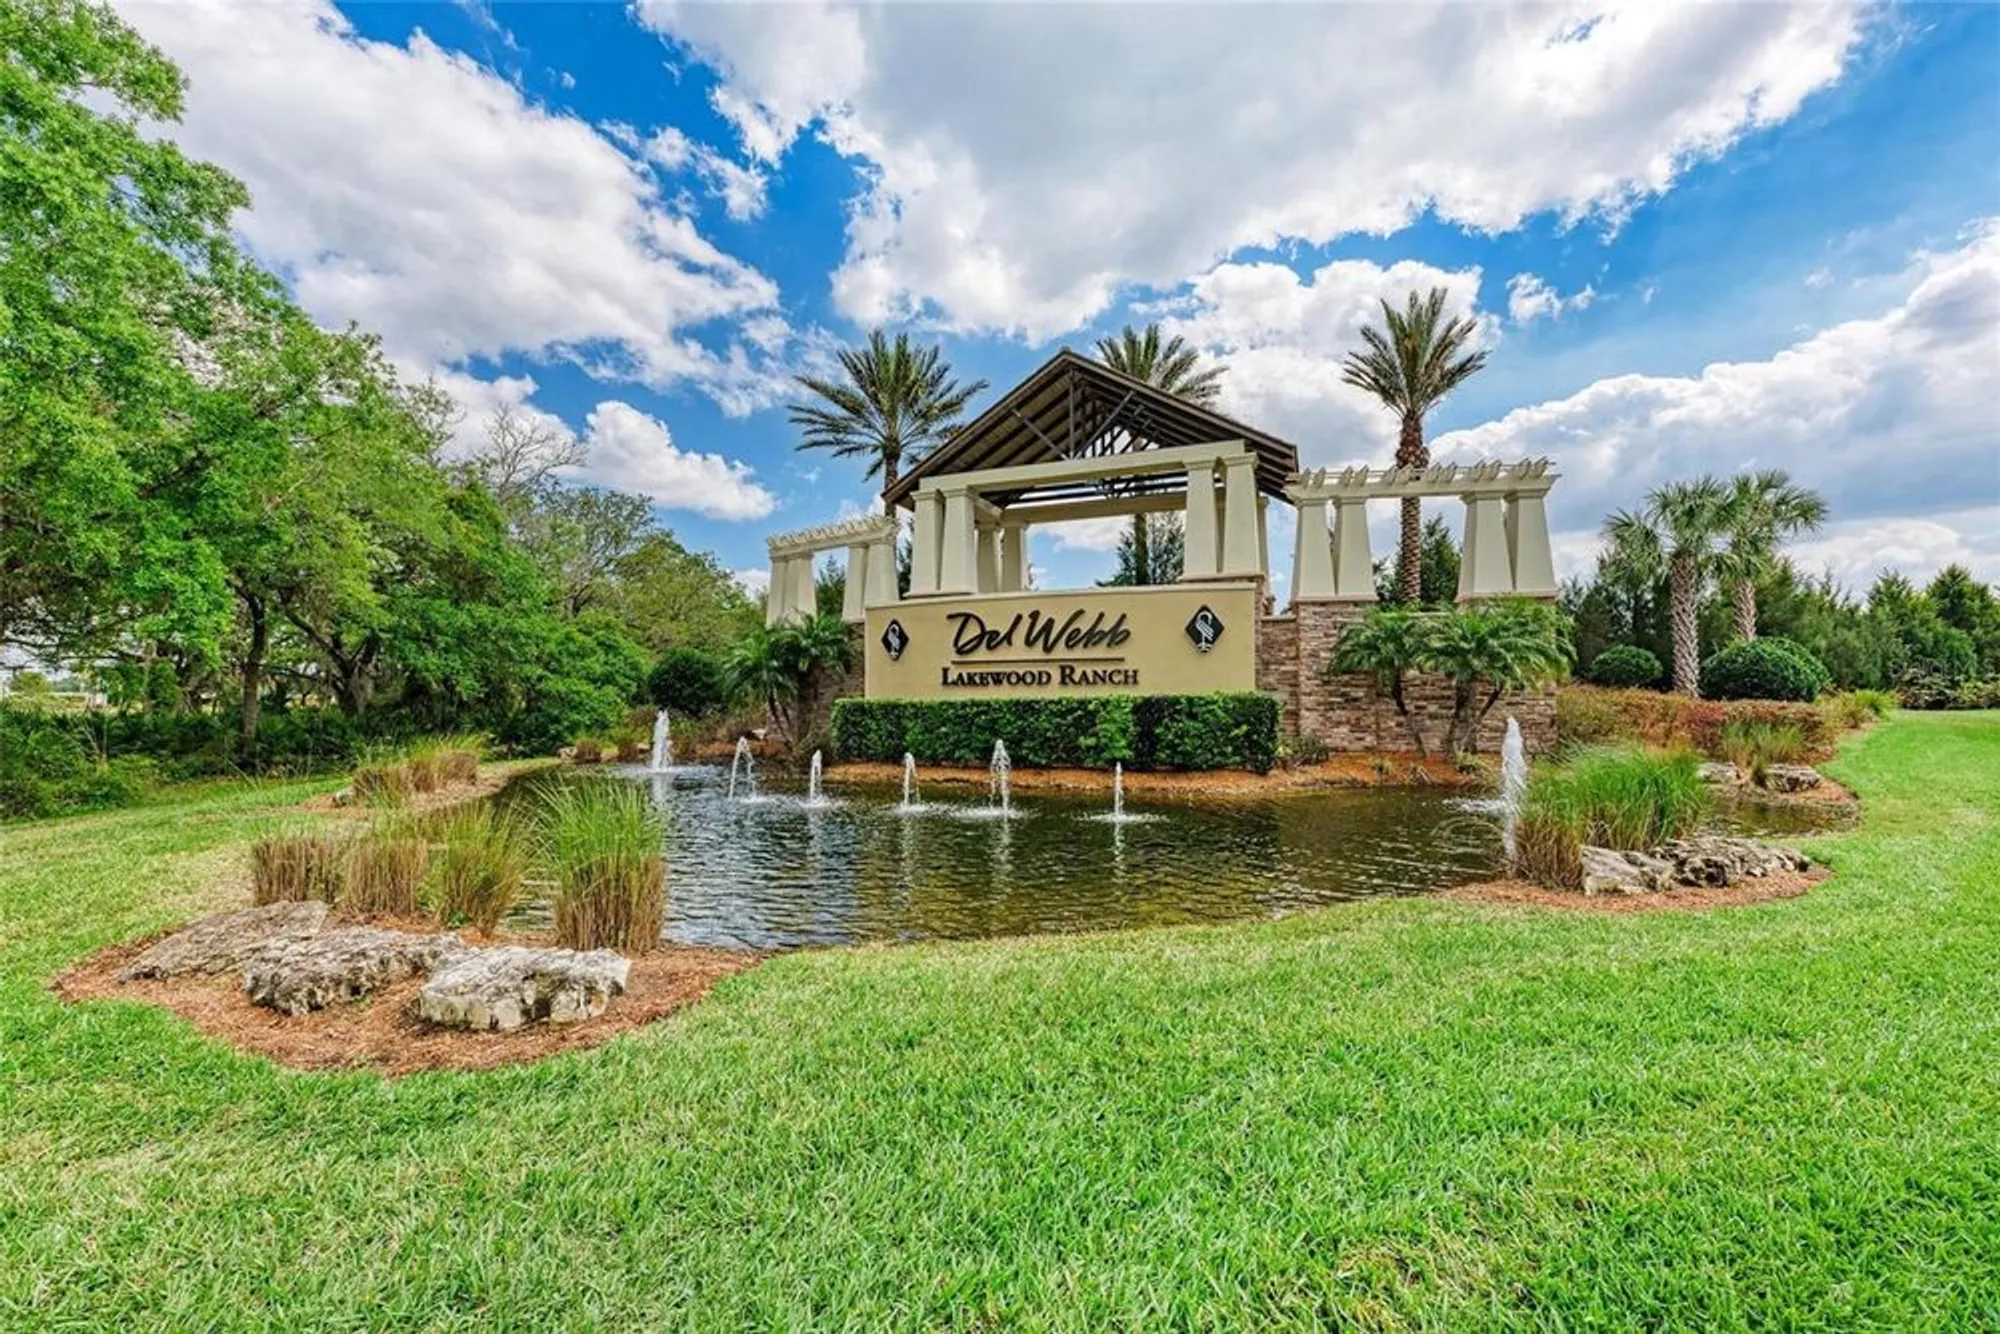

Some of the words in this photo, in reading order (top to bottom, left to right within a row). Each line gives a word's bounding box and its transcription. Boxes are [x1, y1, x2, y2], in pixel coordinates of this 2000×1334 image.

[946, 609, 1023, 655] Del
[1024, 608, 1133, 654] Webb
[941, 667, 1052, 687] LAKEWOOD
[1058, 665, 1139, 686] RANCH
